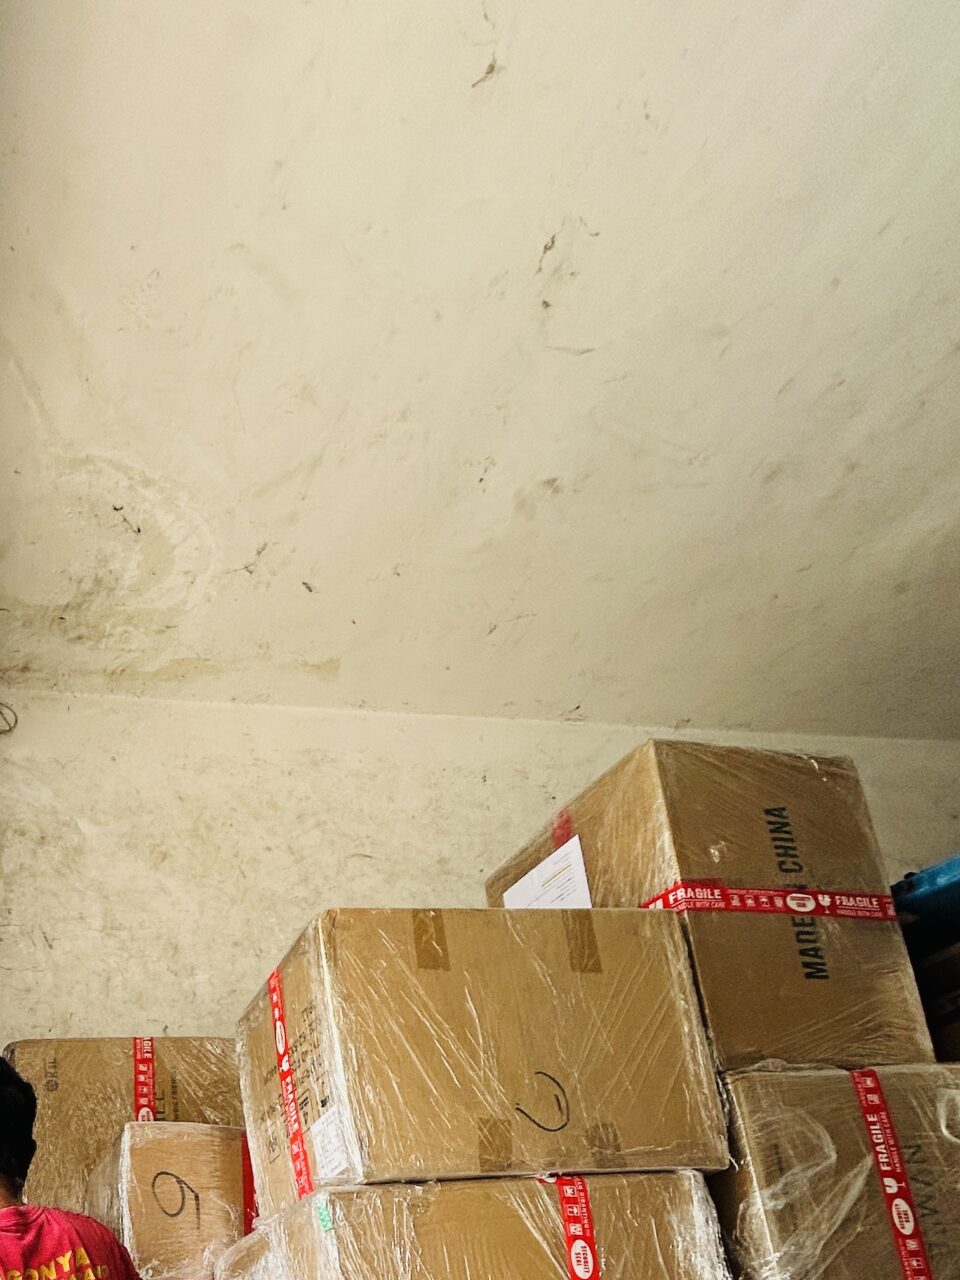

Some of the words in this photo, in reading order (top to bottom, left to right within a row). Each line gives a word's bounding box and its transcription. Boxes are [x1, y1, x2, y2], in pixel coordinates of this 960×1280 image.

[764, 805, 804, 873] CHINA
[669, 887, 722, 904] FRAGILE
[835, 895, 879, 909] FRAGILE
[792, 916, 830, 980] MADE
[866, 1112, 891, 1171] FRAGILE
[581, 1244, 590, 1274] SECURITY
